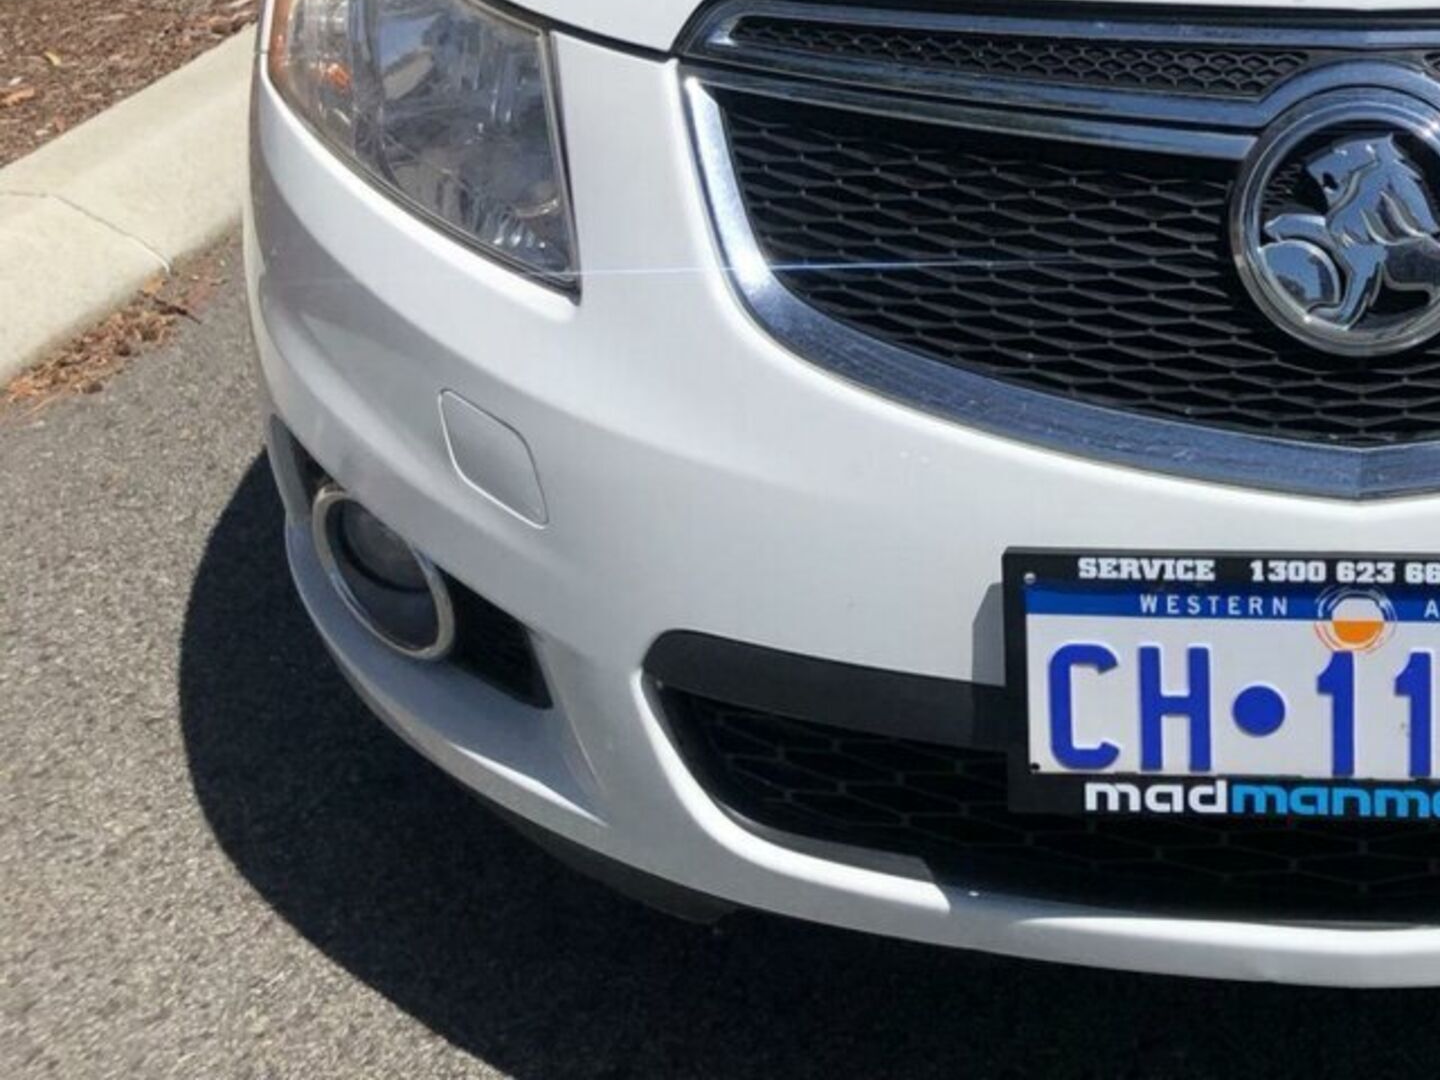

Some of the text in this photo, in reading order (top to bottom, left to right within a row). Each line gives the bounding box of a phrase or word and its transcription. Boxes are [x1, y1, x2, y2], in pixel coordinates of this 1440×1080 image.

[1078, 557, 1216, 581] SERVICE
[1250, 560, 1326, 583] 1300
[1336, 561, 1395, 583] 623
[1140, 593, 1289, 616] WESTERN
